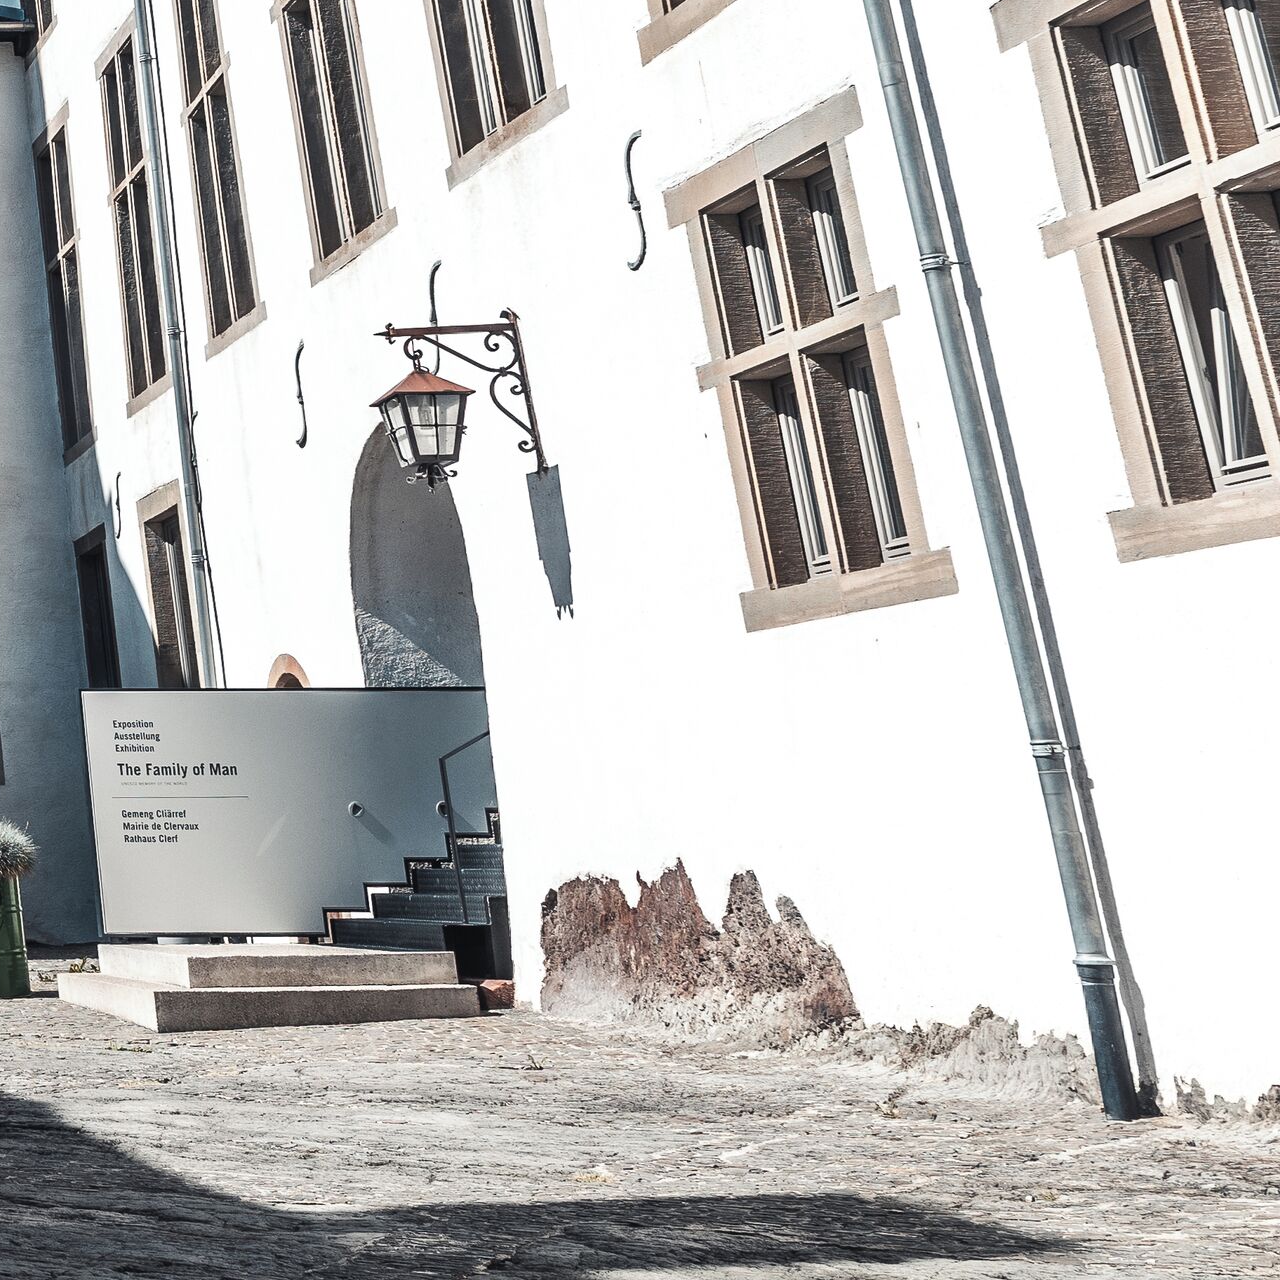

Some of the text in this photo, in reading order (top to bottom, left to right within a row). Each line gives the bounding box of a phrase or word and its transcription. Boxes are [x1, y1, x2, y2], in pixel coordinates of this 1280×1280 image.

[112, 720, 154, 730] Exposition
[114, 732, 161, 742] Ausstellung
[115, 744, 155, 753] Exhibition
[117, 762, 238, 779] The Family of Man
[121, 809, 187, 820] Gemeng Cliärref
[123, 822, 200, 831] Mairie de Clervaux
[124, 834, 178, 843] Rathaus Clerf
